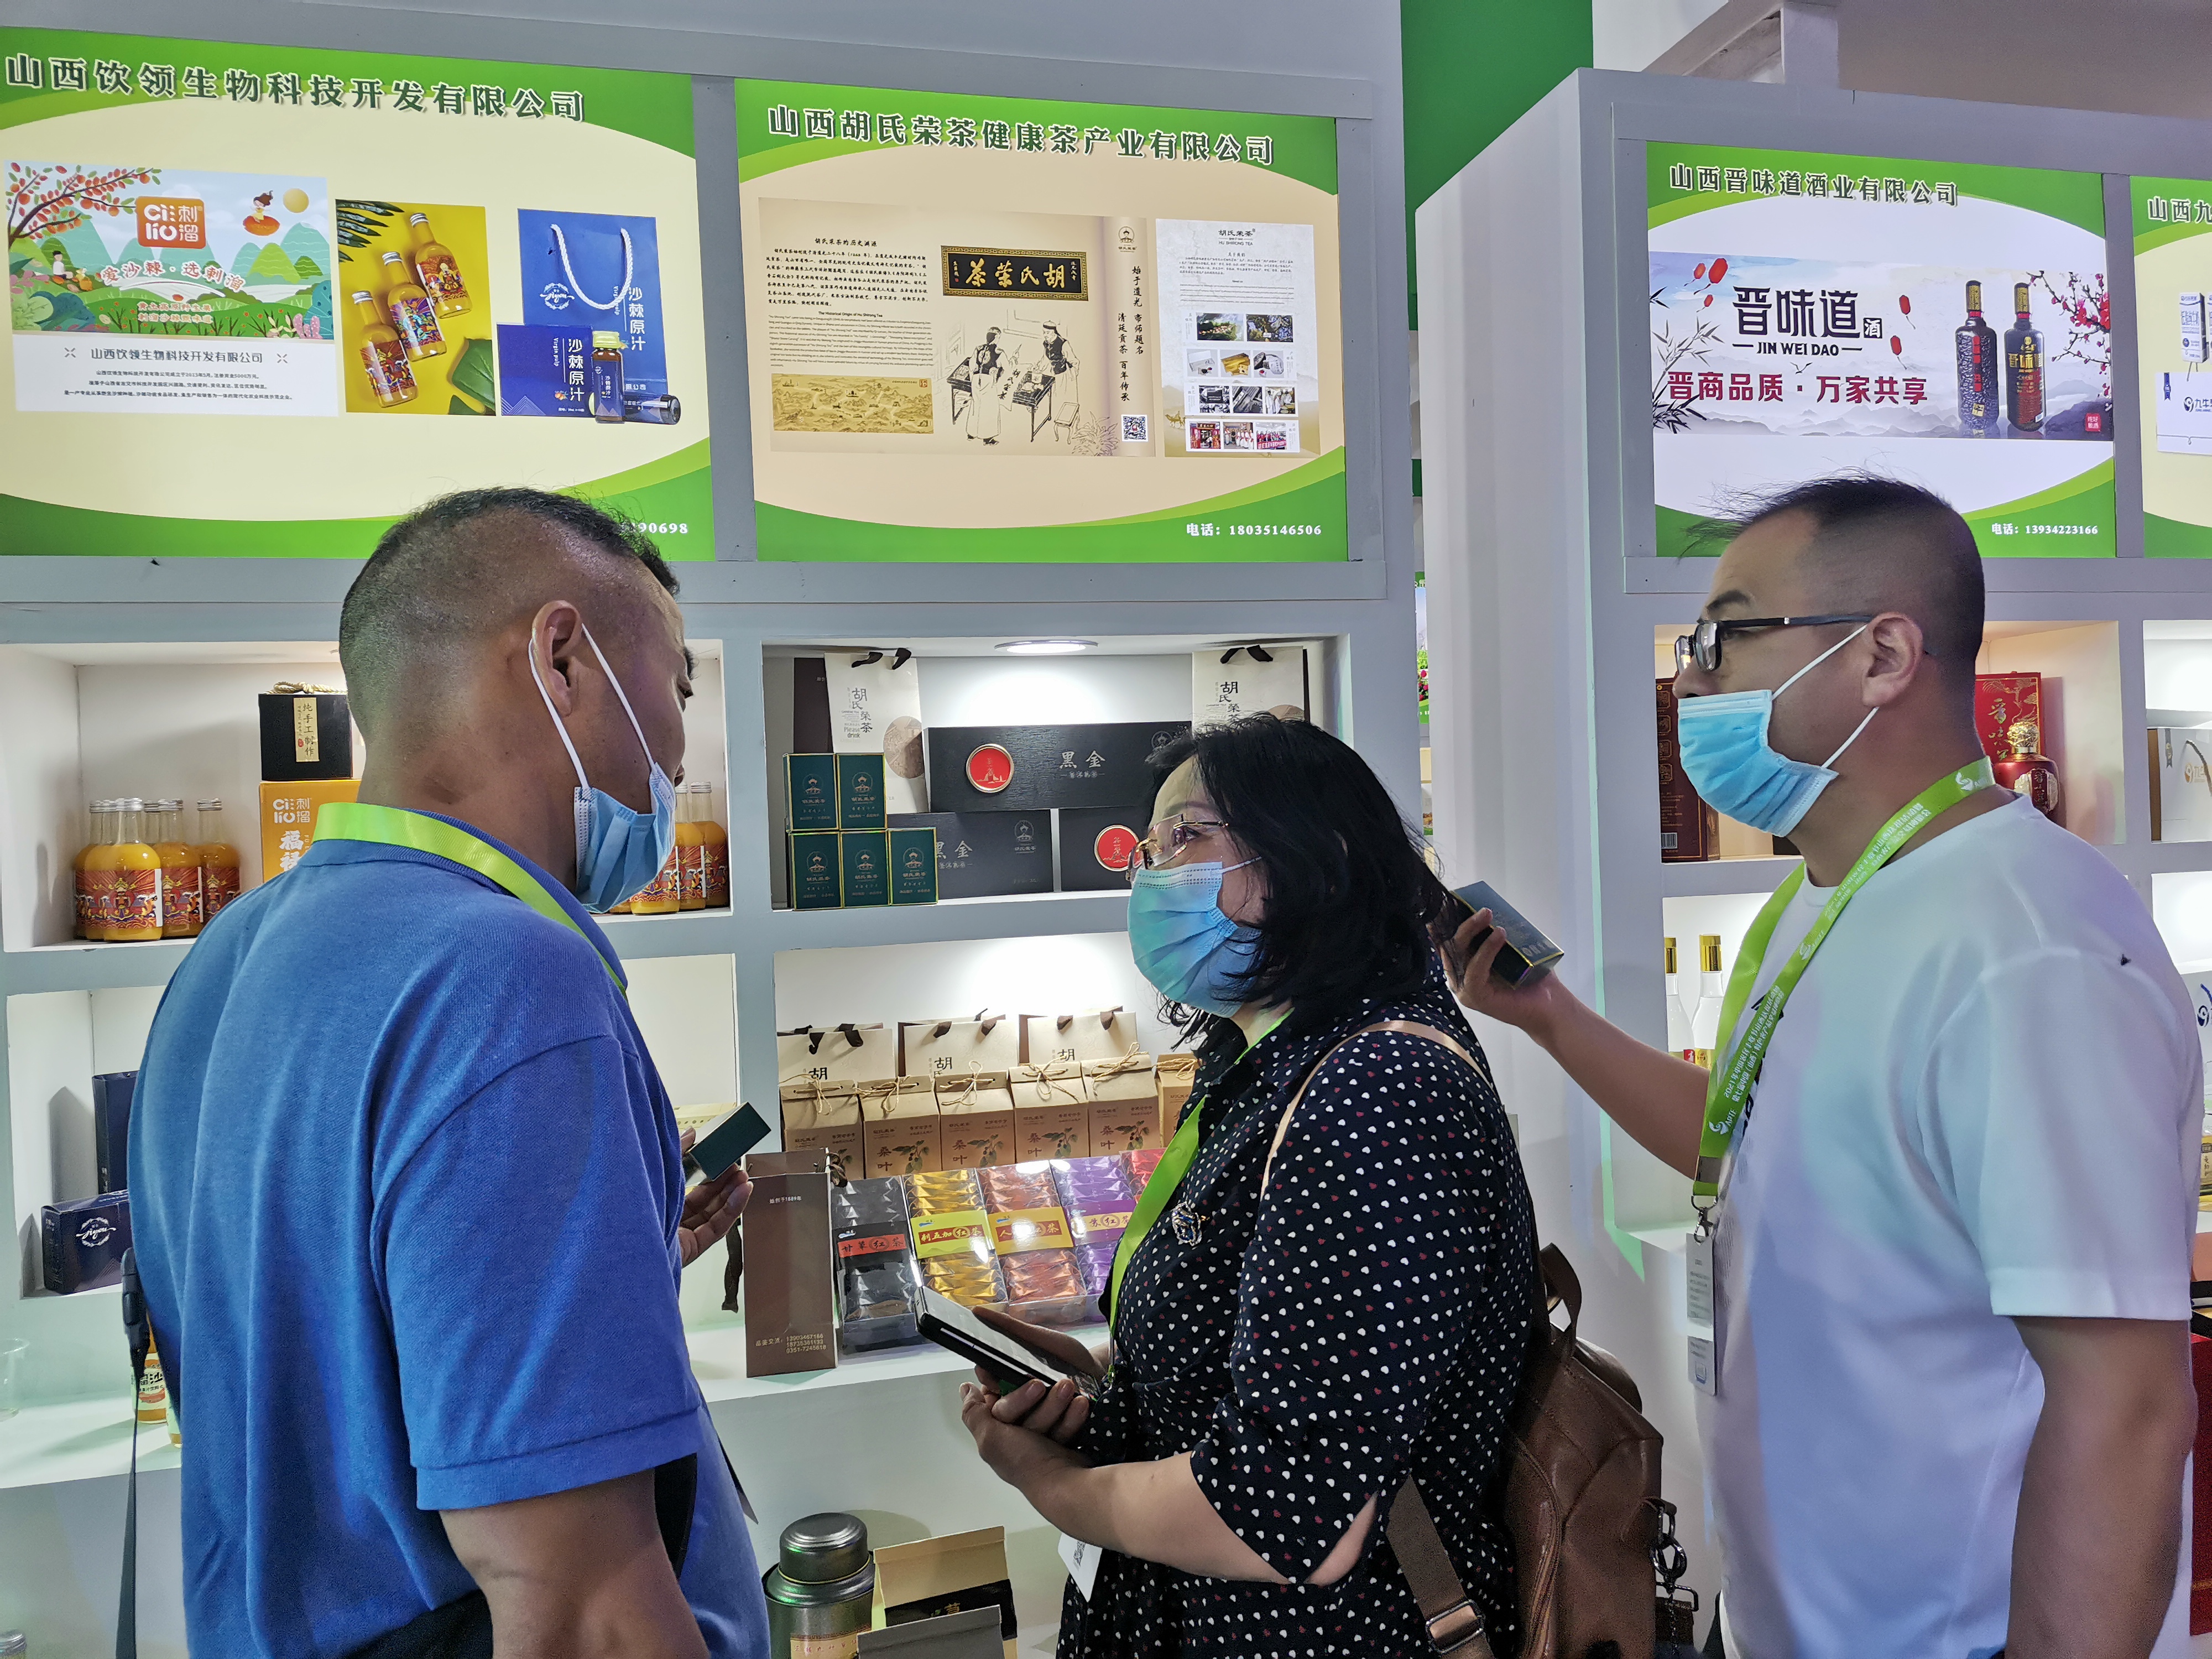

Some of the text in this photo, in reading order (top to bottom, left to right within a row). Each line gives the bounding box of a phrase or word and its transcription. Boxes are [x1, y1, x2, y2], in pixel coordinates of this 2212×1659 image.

[4, 52, 586, 122] 山西饮领生物科技开发有限公司
[768, 103, 1274, 165] 山西胡氏荣茶健康茶产业有限公司
[1670, 163, 1958, 206] 山西晋味道酒业有限公司
[1132, 266, 1142, 307] 始于道光
[629, 286, 645, 351] 沙棘原汁
[1733, 286, 1861, 338] 晋味道
[1864, 318, 1882, 338] 酒
[91, 348, 263, 363] 山西饮领生物科技开发有限公司
[1757, 342, 1839, 356] JIN WEI DAO
[568, 338, 585, 401] 沙棘原汁
[1119, 361, 1130, 401] 百年传承
[1667, 372, 1928, 404] 晋商品质·万家共享
[632, 521, 688, 535] 90698
[1229, 525, 1322, 535] 18035146506
[2025, 525, 2098, 535] 13934223166
[302, 702, 316, 757] 纯手工制作
[1060, 749, 1106, 769] 黑金
[808, 1067, 828, 1080] 胡
[1027, 1133, 1043, 1157] 桑叶
[1100, 1125, 1115, 1150] 桑叶
[877, 1146, 893, 1171] 桑叶
[952, 1140, 967, 1165] 桑叶
